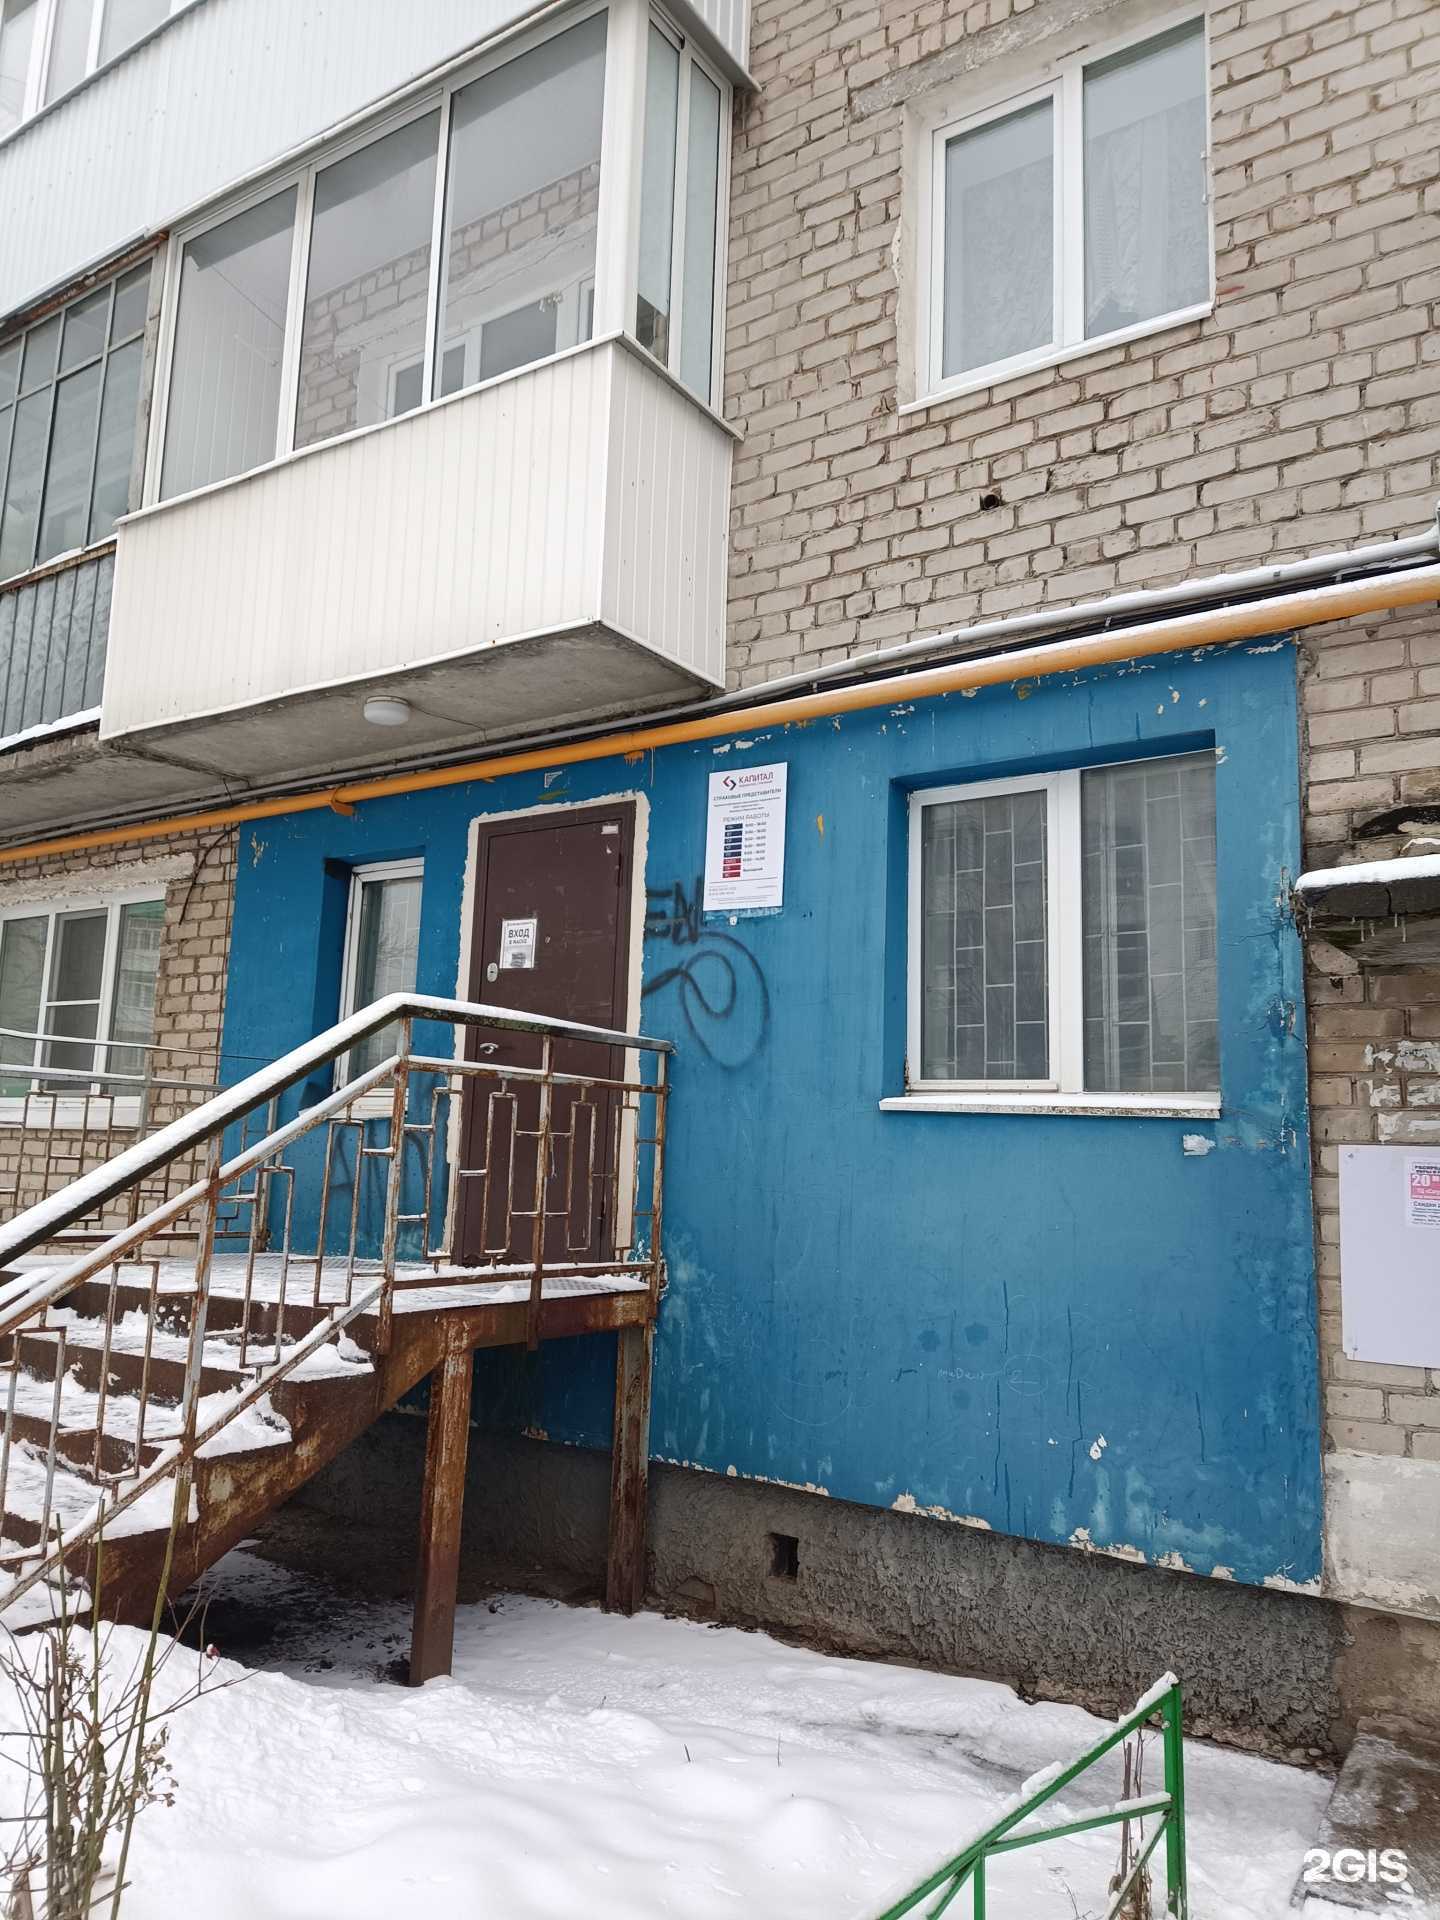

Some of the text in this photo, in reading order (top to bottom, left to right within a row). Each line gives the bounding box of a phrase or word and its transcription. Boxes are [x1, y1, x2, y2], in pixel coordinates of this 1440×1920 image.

[739, 772, 774, 784] КАПИТАЛ
[508, 929, 530, 938] ВХОД
[1412, 1174, 1431, 1187] 20
